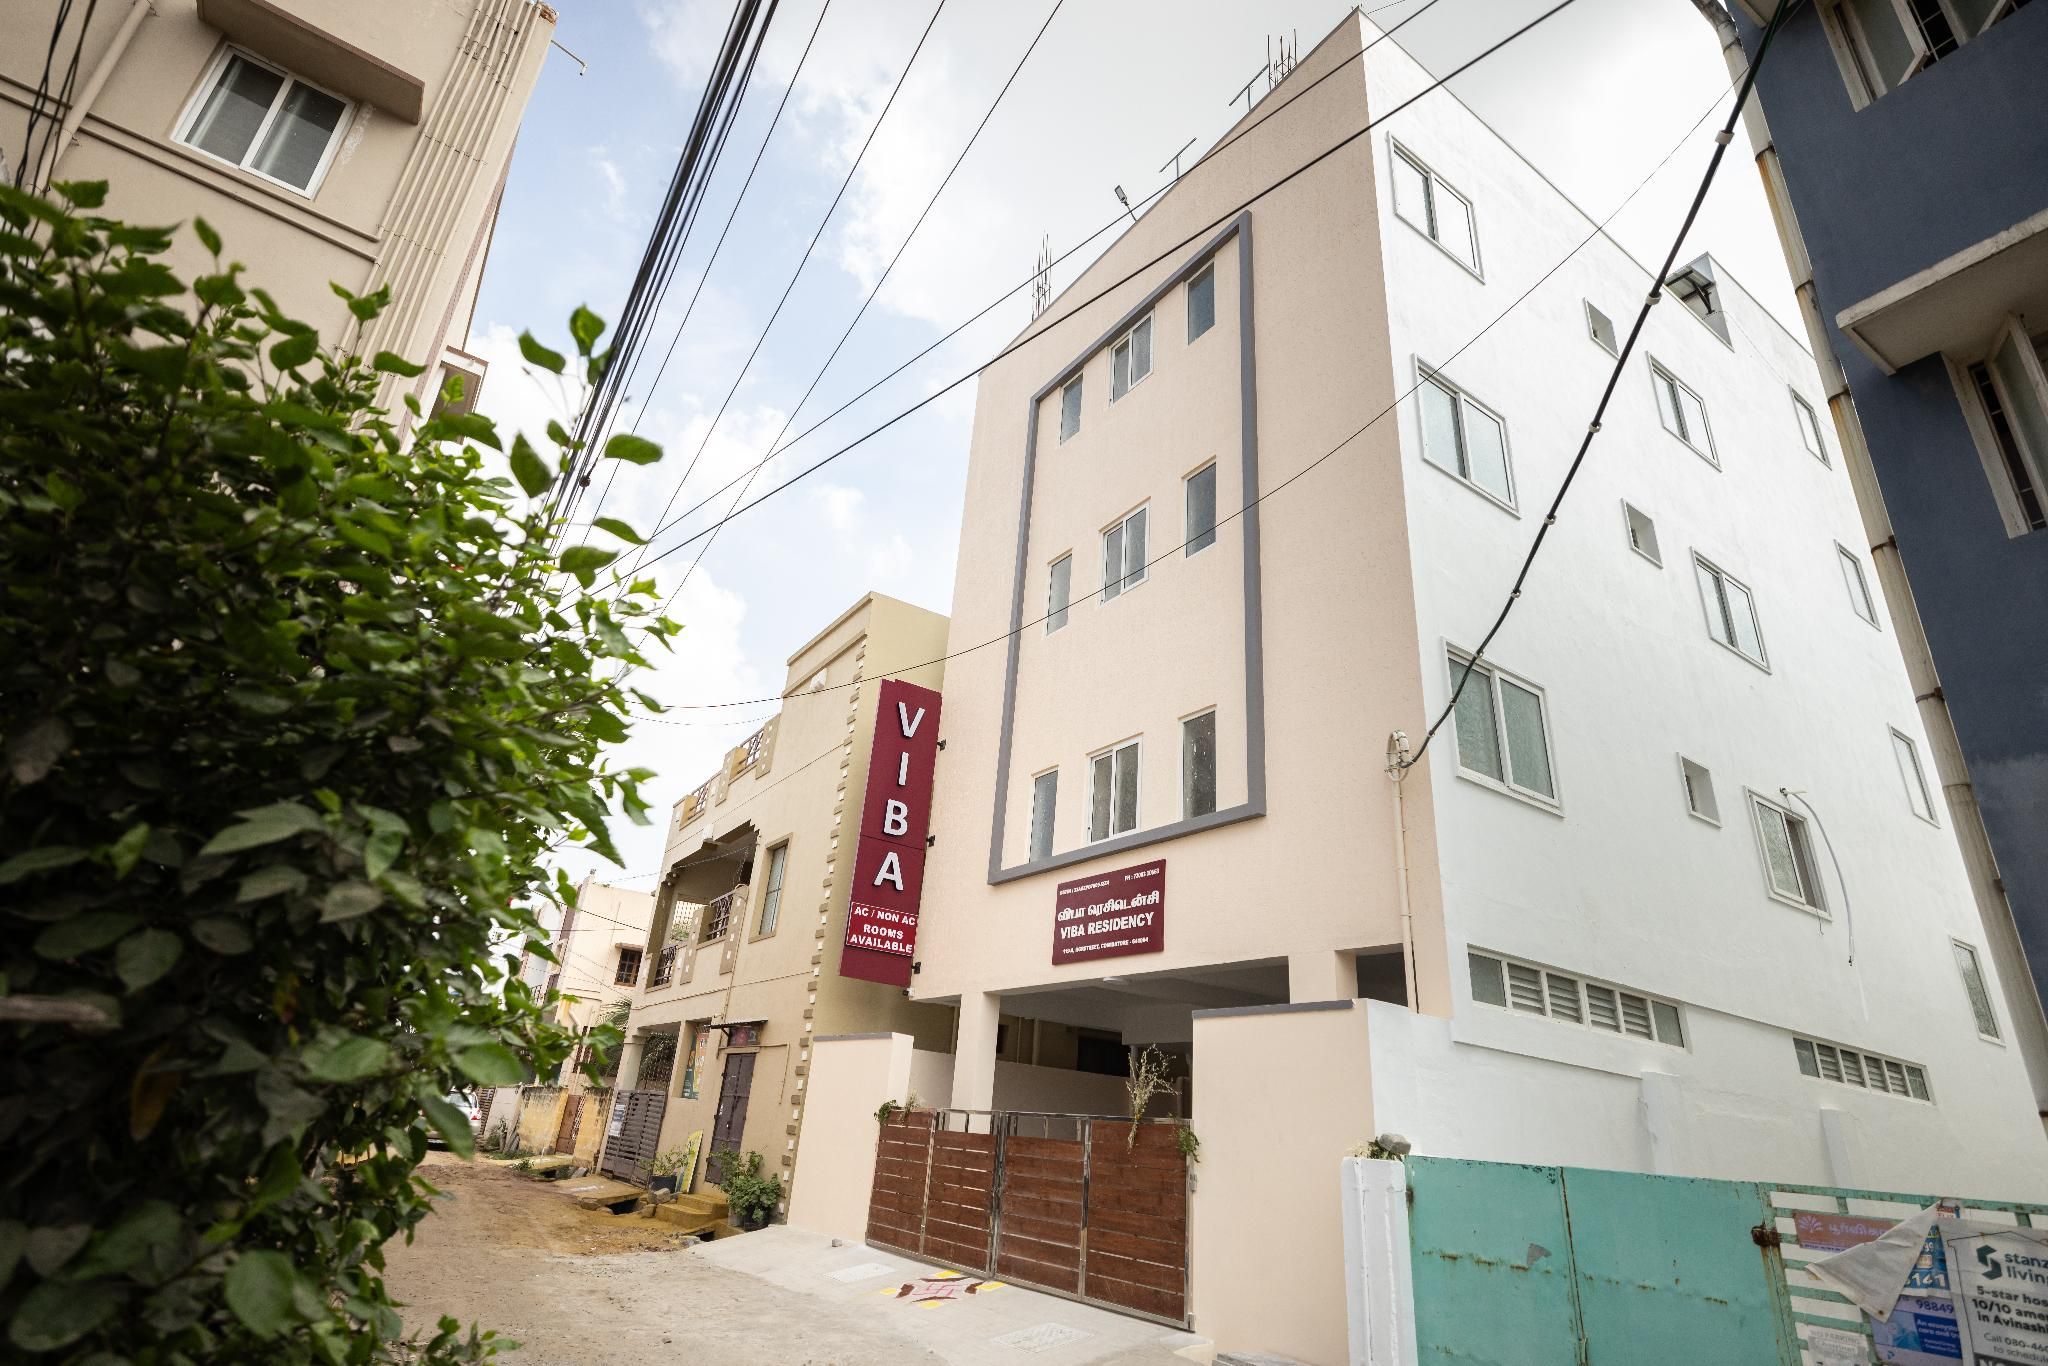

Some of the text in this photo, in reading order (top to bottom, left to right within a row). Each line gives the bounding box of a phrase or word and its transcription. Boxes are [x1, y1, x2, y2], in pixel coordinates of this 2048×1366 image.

[873, 702, 926, 891] VIBA
[854, 907, 869, 917] AC
[877, 910, 900, 923] NON
[901, 916, 916, 926] AC
[863, 923, 904, 940] ROOMS
[1060, 912, 1155, 940] VIBA RESIDENCY
[850, 934, 913, 954] AVAILABLE
[2006, 1265, 2048, 1287] livin
[1976, 1285, 2019, 1301] 5-star
[1916, 1299, 1955, 1314] 98849
[1972, 1298, 2011, 1314] 10/10
[1977, 1310, 1990, 1322] in
